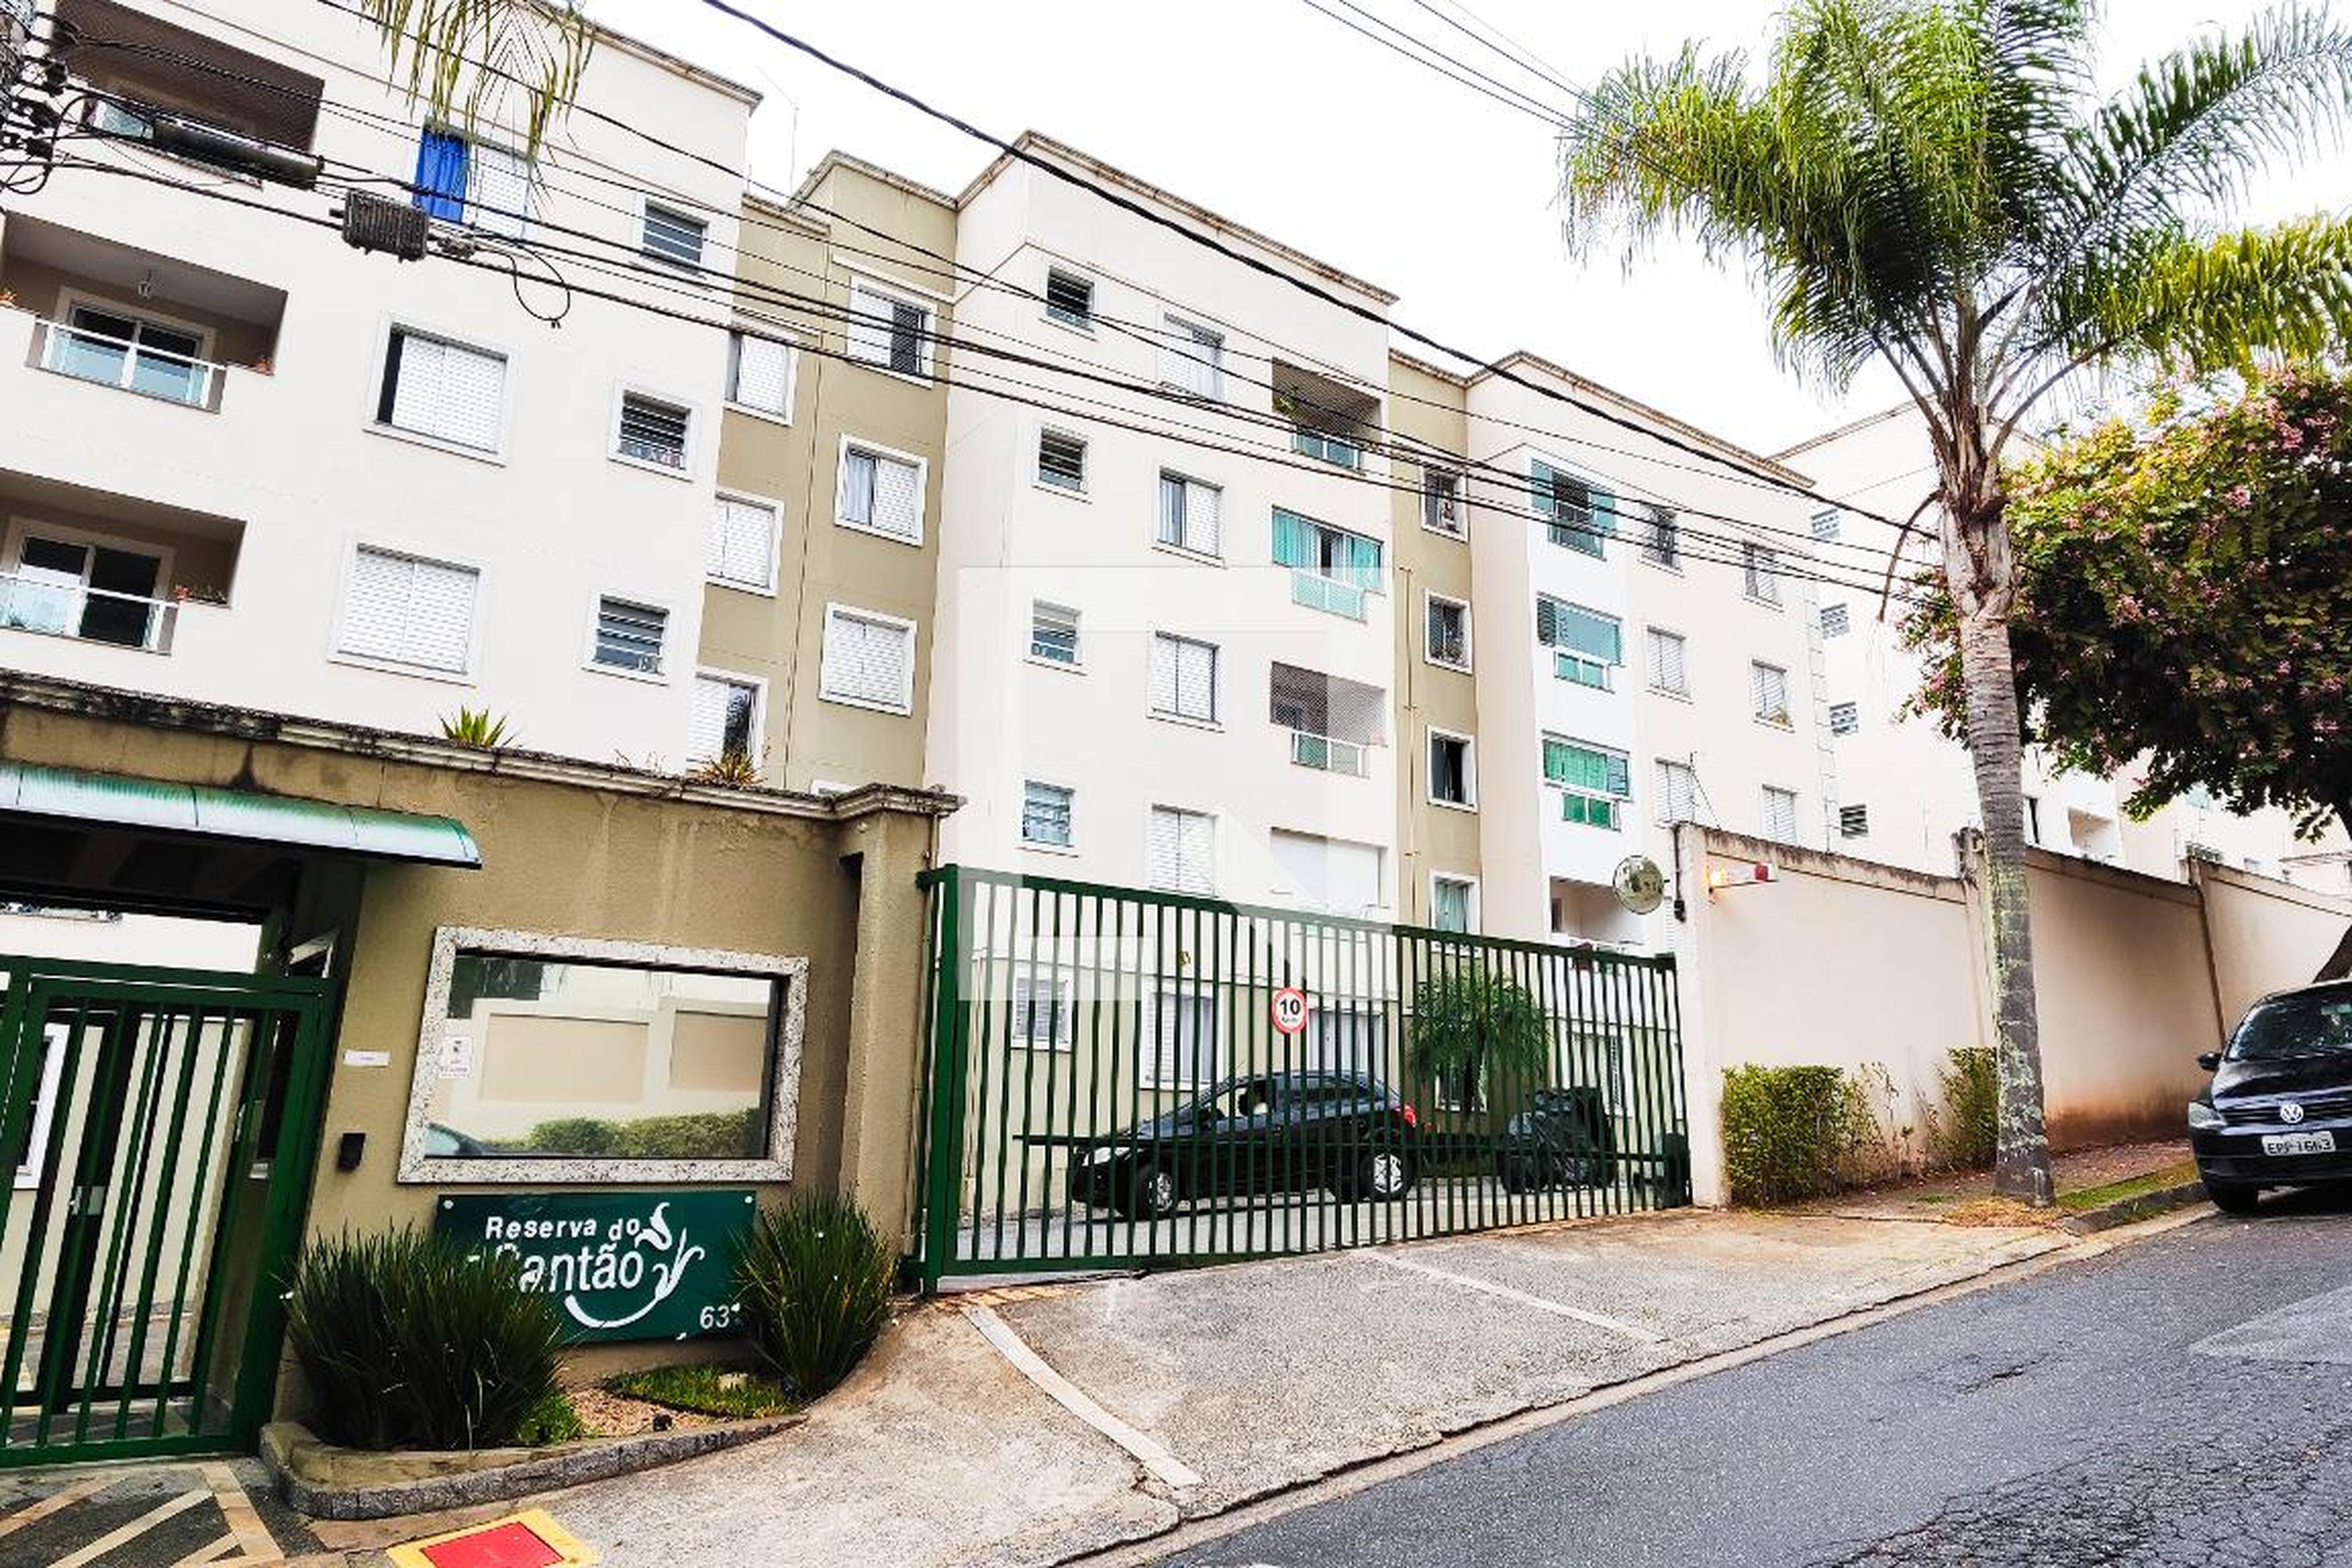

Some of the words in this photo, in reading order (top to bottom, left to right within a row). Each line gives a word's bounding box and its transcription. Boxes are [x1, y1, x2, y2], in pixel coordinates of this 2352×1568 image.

[1280, 998, 1301, 1015] 10
[485, 1216, 597, 1240] Reserva
[608, 1218, 641, 1242] do
[699, 1302, 741, 1330] 63
